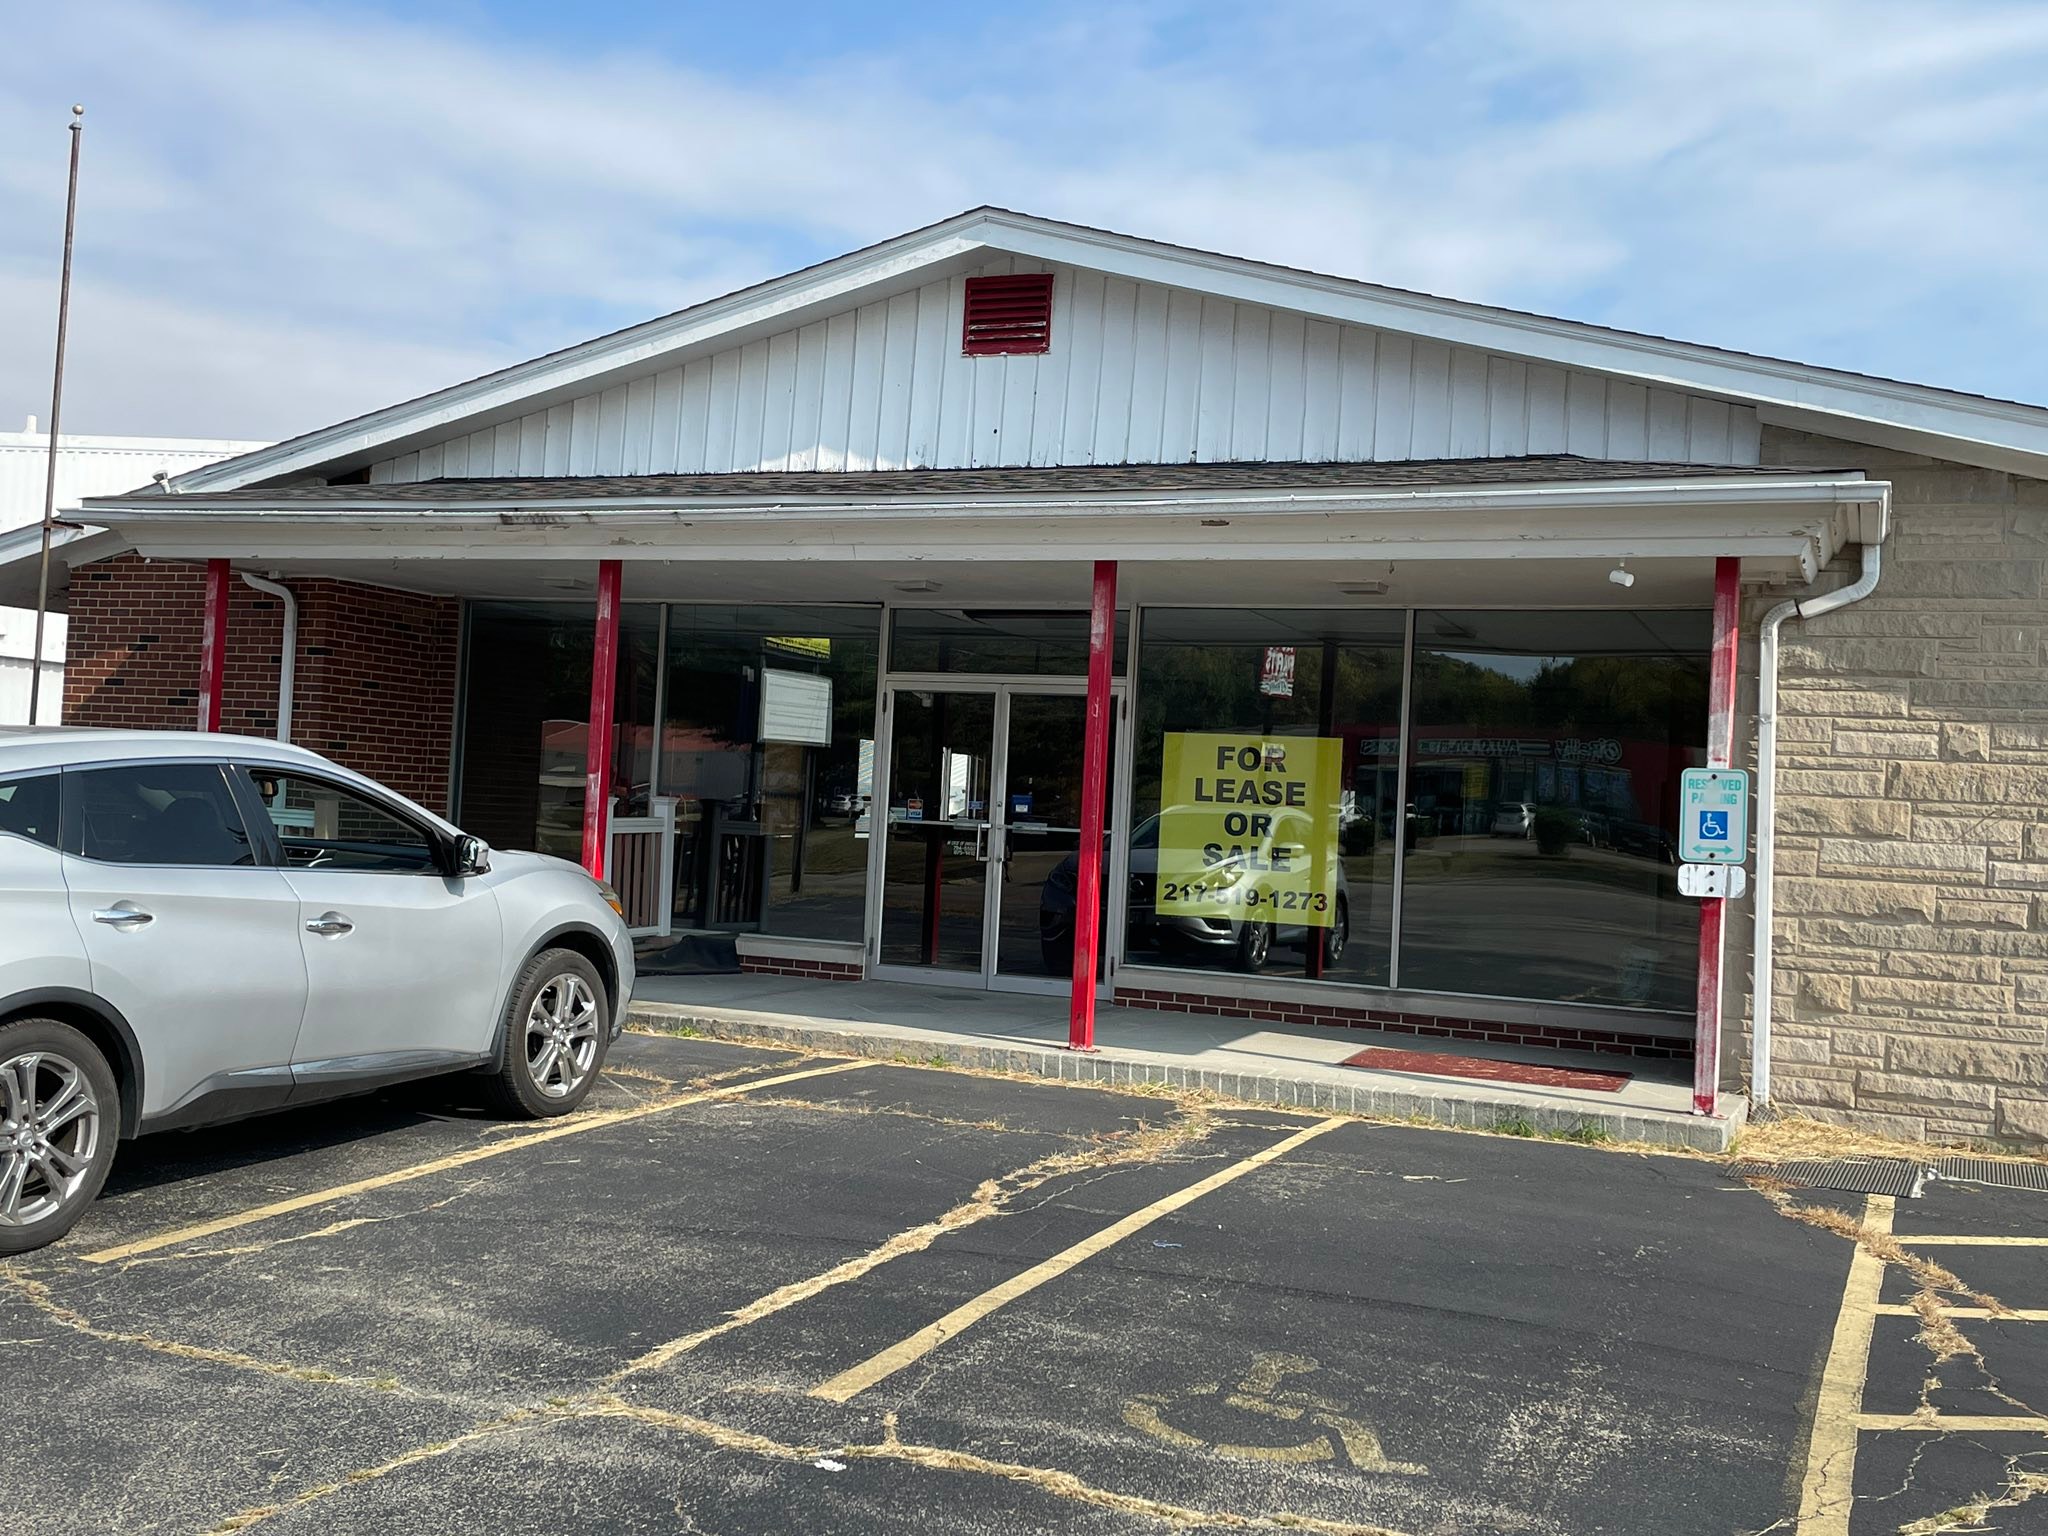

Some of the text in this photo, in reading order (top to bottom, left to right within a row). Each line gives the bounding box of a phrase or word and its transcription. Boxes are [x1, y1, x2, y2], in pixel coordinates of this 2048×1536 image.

[1216, 746, 1287, 773] FOR
[1194, 777, 1306, 807] LEASE
[1688, 778, 1742, 791] RESVED
[1224, 811, 1273, 838] OR
[1202, 842, 1292, 873] SALE
[1163, 882, 1329, 912] 217-519-1273
